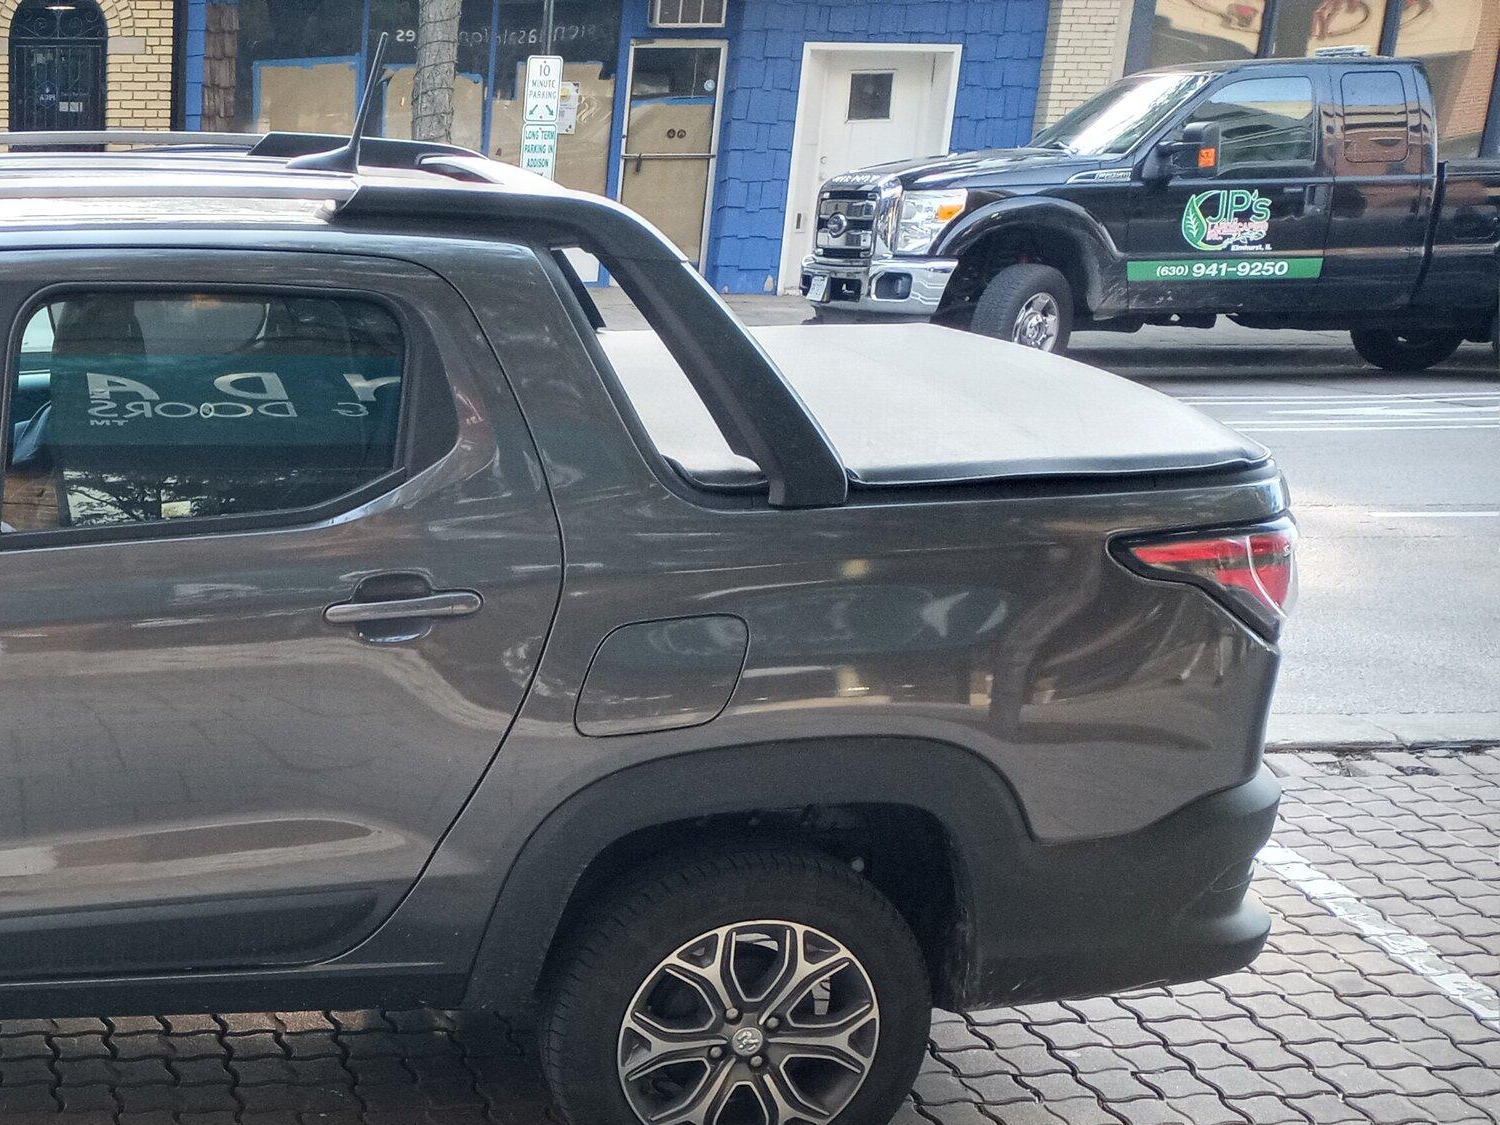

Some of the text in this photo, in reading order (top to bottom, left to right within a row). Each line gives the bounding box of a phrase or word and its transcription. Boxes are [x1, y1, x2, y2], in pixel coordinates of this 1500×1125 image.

[539, 65, 551, 77] 10
[531, 80, 555, 88] MINUTE
[529, 90, 556, 99] PARKING
[525, 130, 554, 140] LONG TERM
[525, 144, 554, 154] PARKING IN
[527, 158, 549, 167] ADDISON
[1206, 189, 1272, 222] JP's
[1156, 261, 1288, 277] (630) 941-9250
